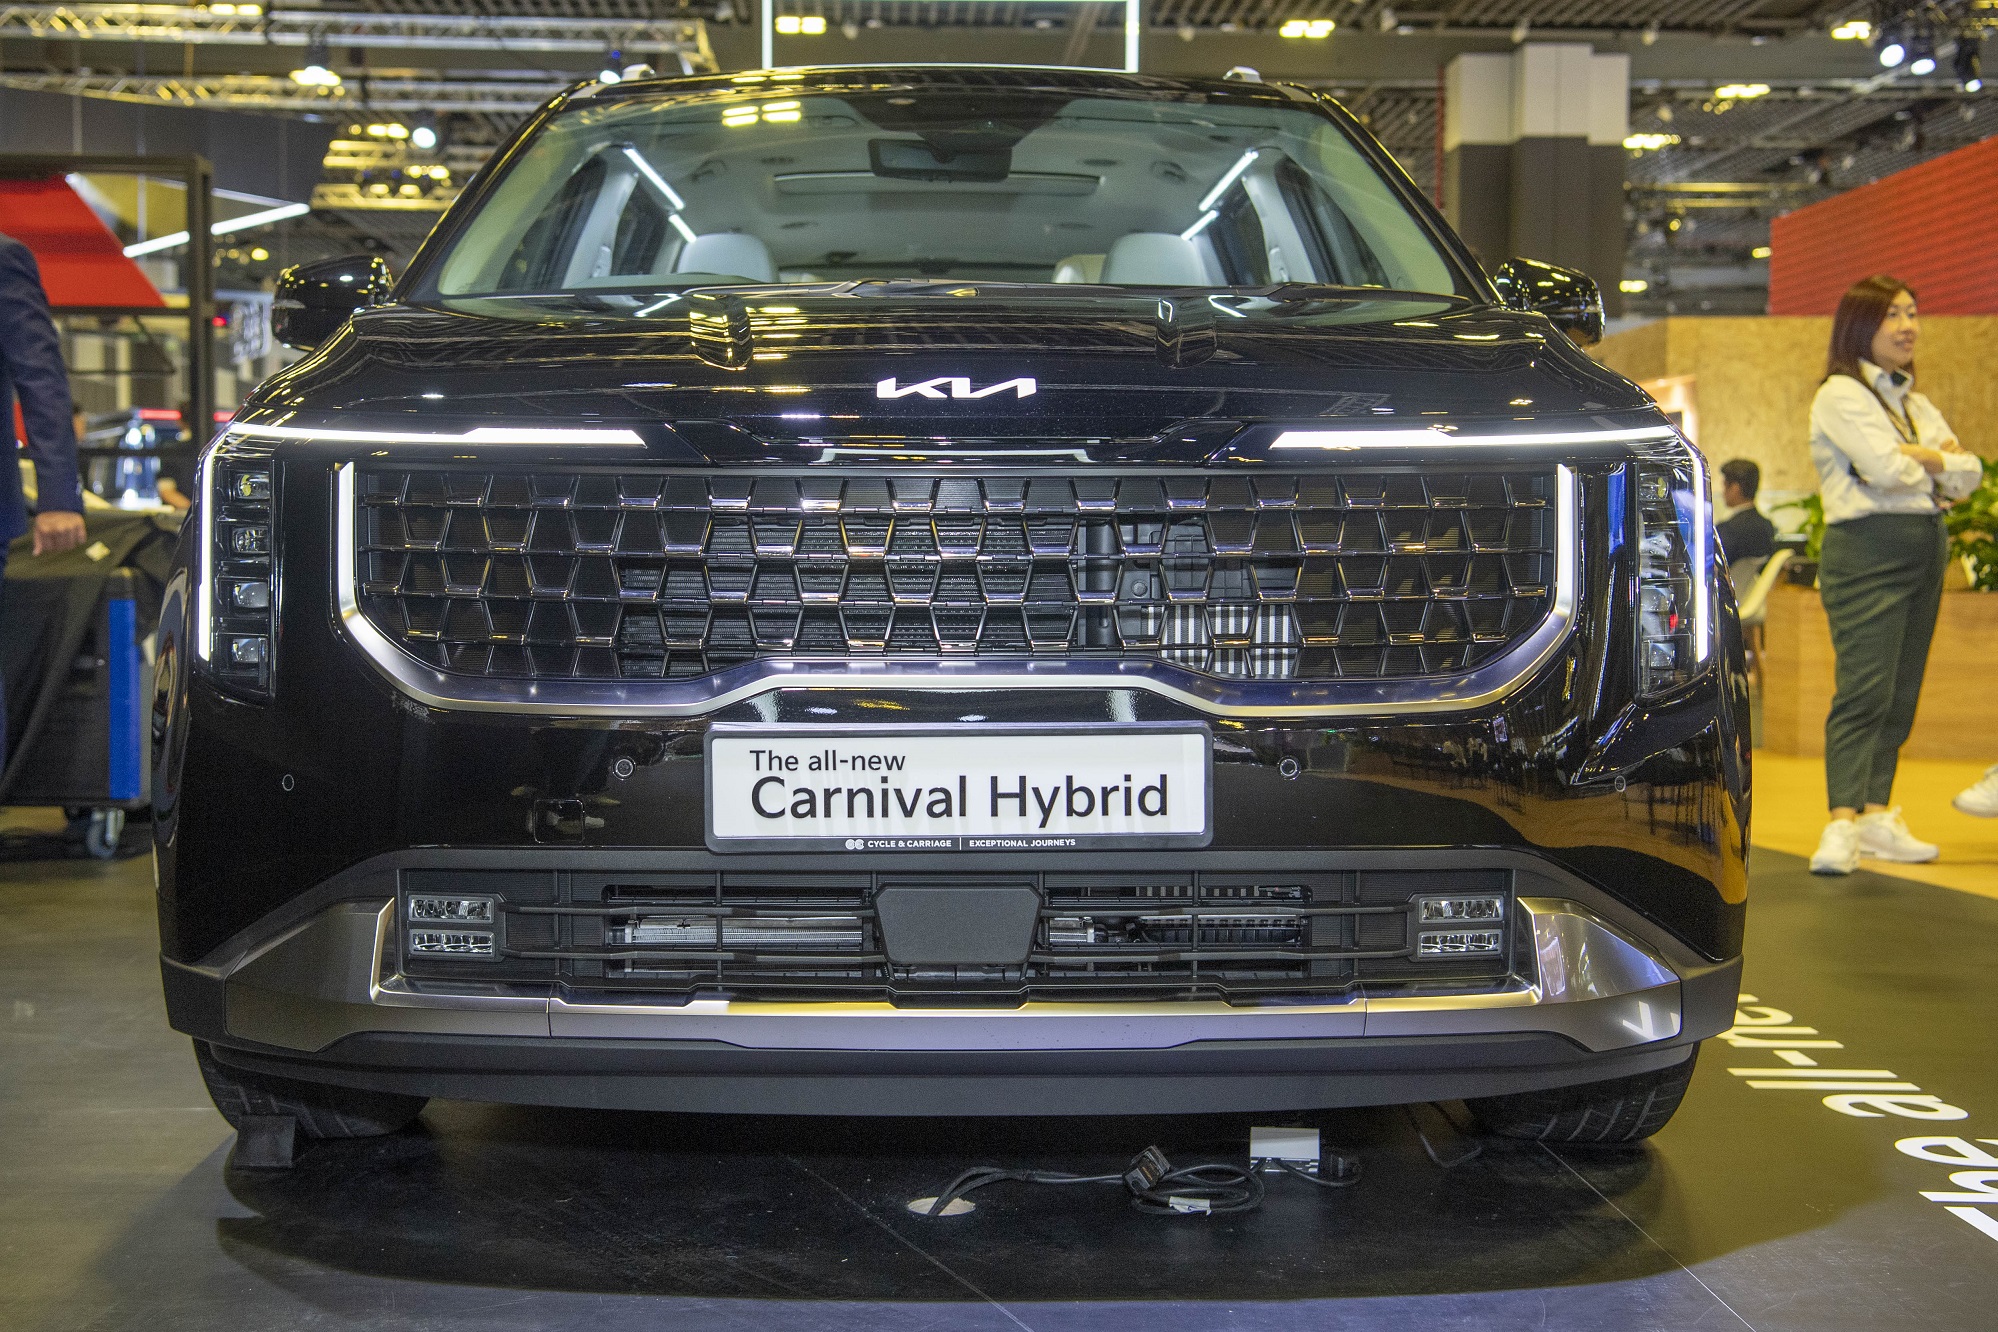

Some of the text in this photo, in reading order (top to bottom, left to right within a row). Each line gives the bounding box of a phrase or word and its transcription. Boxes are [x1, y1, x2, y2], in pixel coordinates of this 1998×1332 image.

[876, 377, 1037, 399] KIA
[750, 750, 906, 771] The all-new
[751, 774, 1168, 829] Carnival Hybrid
[867, 839, 1076, 848] CYCLE & CARRIAGE EXCEPTIONAL JOURNEYS
